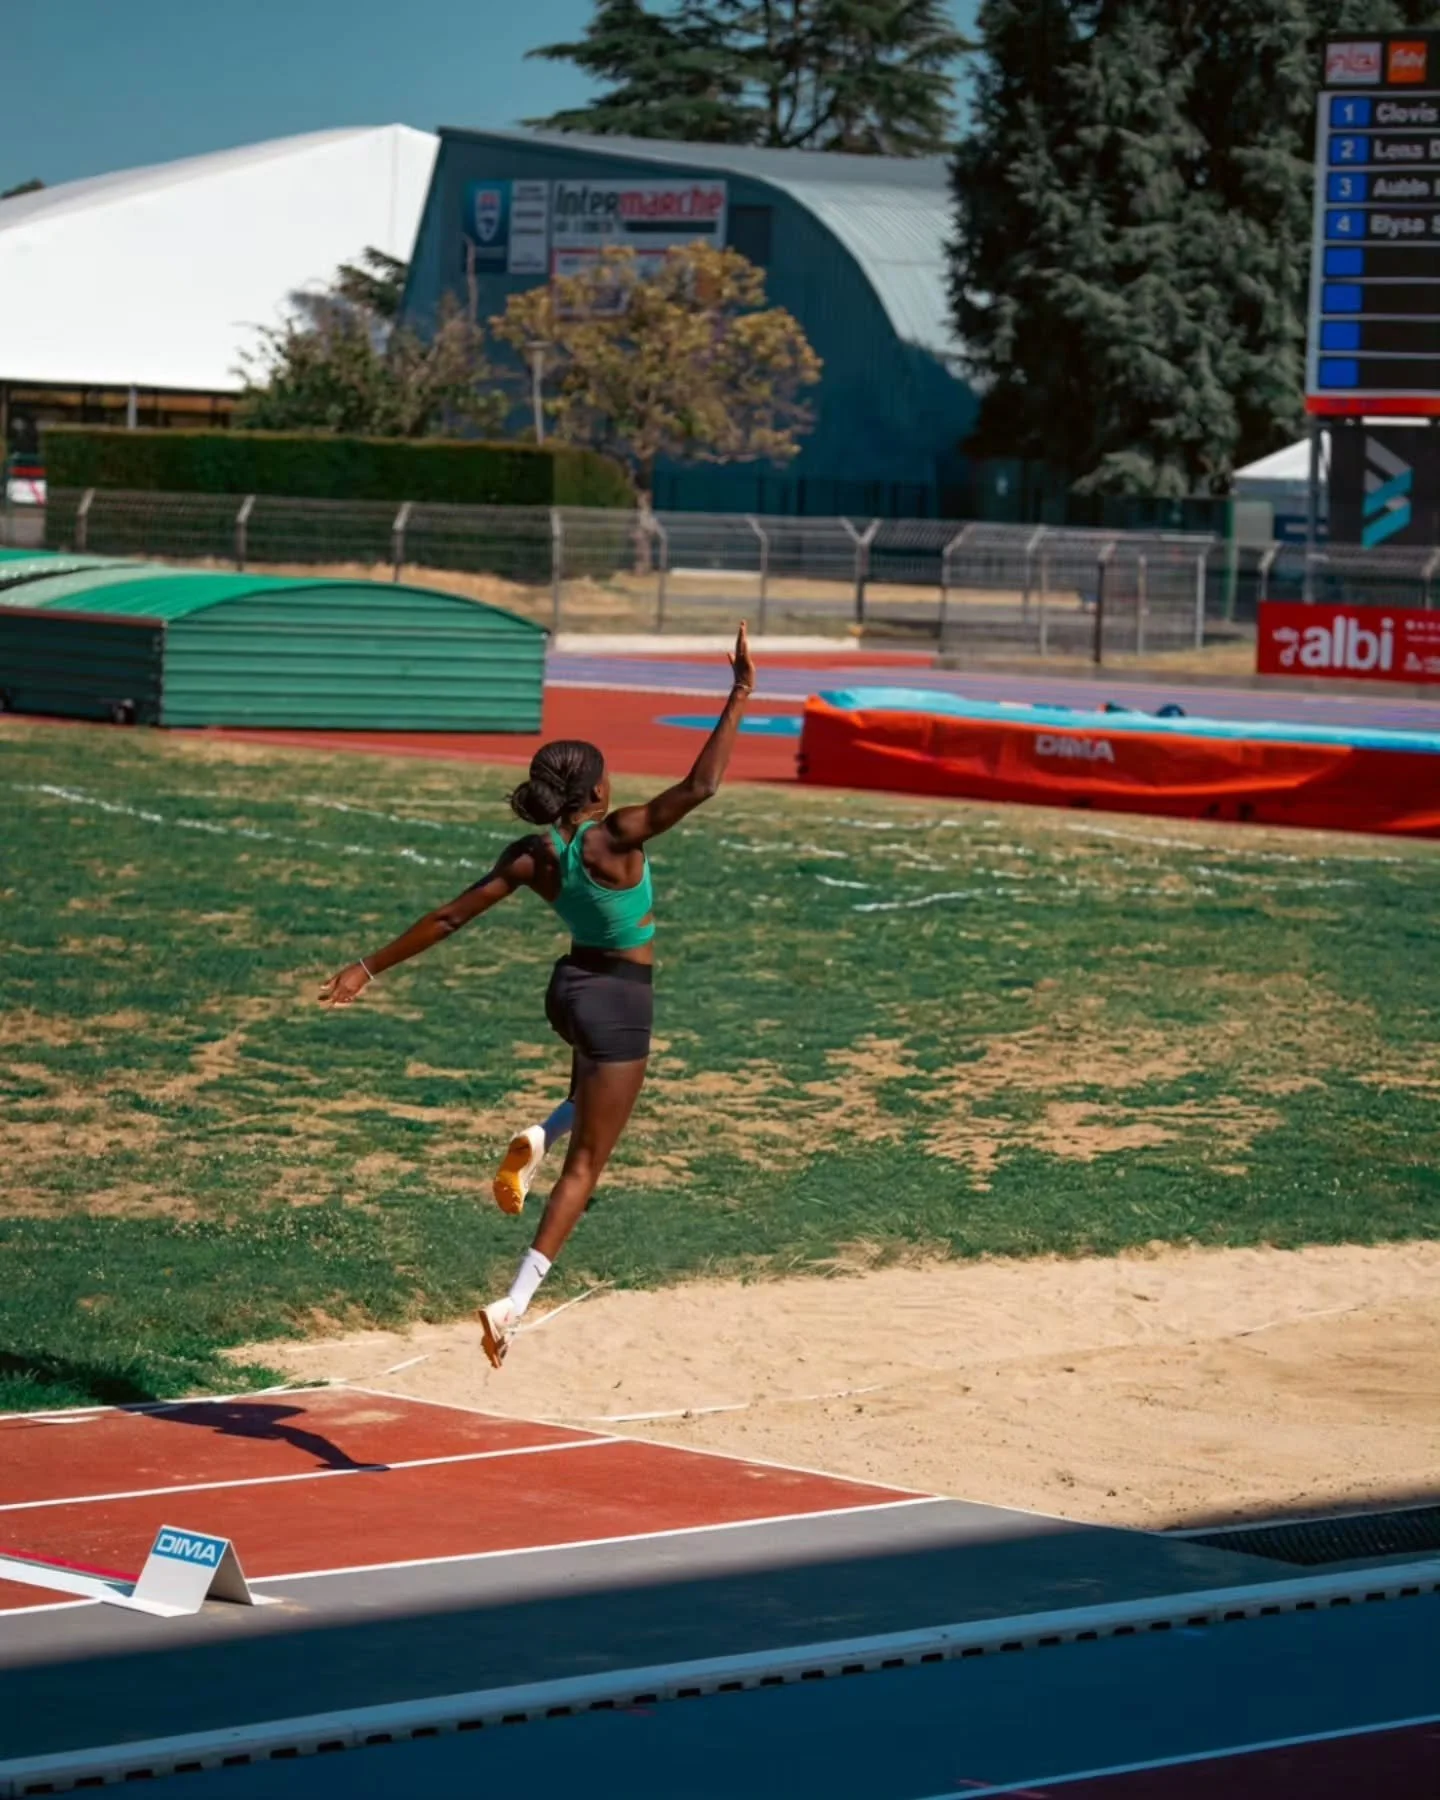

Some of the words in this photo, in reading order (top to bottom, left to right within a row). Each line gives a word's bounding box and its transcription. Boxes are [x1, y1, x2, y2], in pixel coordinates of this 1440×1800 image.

[1344, 103, 1354, 123] 1
[1341, 140, 1354, 159] 2
[1339, 177, 1352, 197] 3
[1336, 215, 1350, 232] 4
[1300, 614, 1394, 671] albi
[156, 1533, 217, 1563] DIMA
